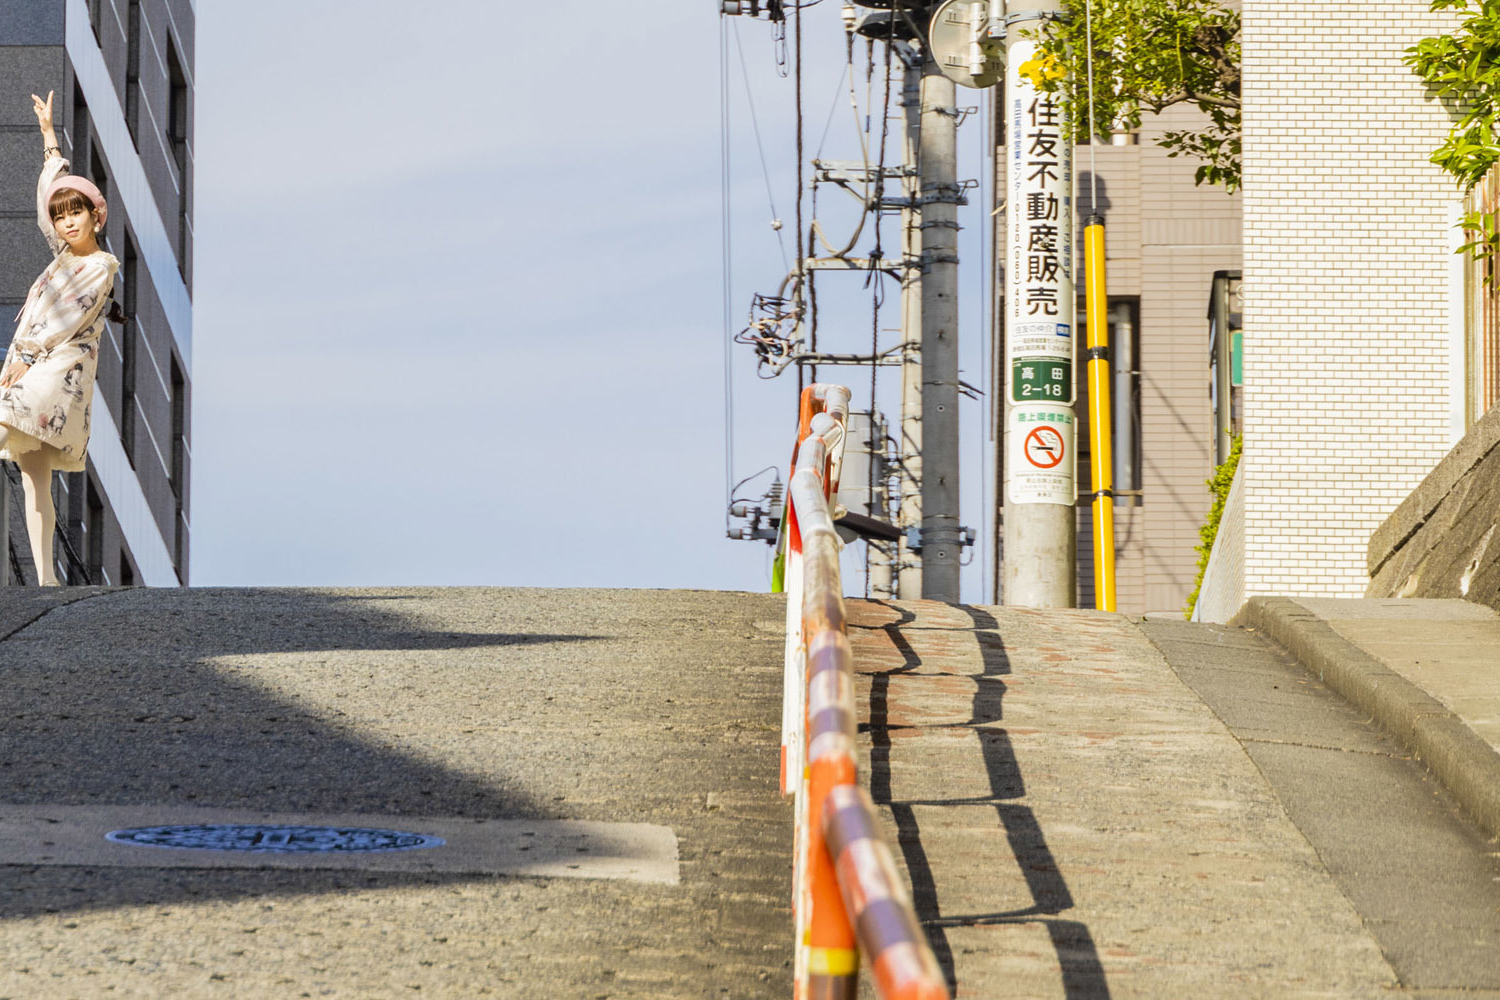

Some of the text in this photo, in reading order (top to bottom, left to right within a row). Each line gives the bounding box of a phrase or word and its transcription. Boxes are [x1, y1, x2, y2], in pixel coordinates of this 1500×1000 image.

[1026, 97, 1059, 316] 住友不動産販売
[1021, 383, 1062, 397] 2-18
